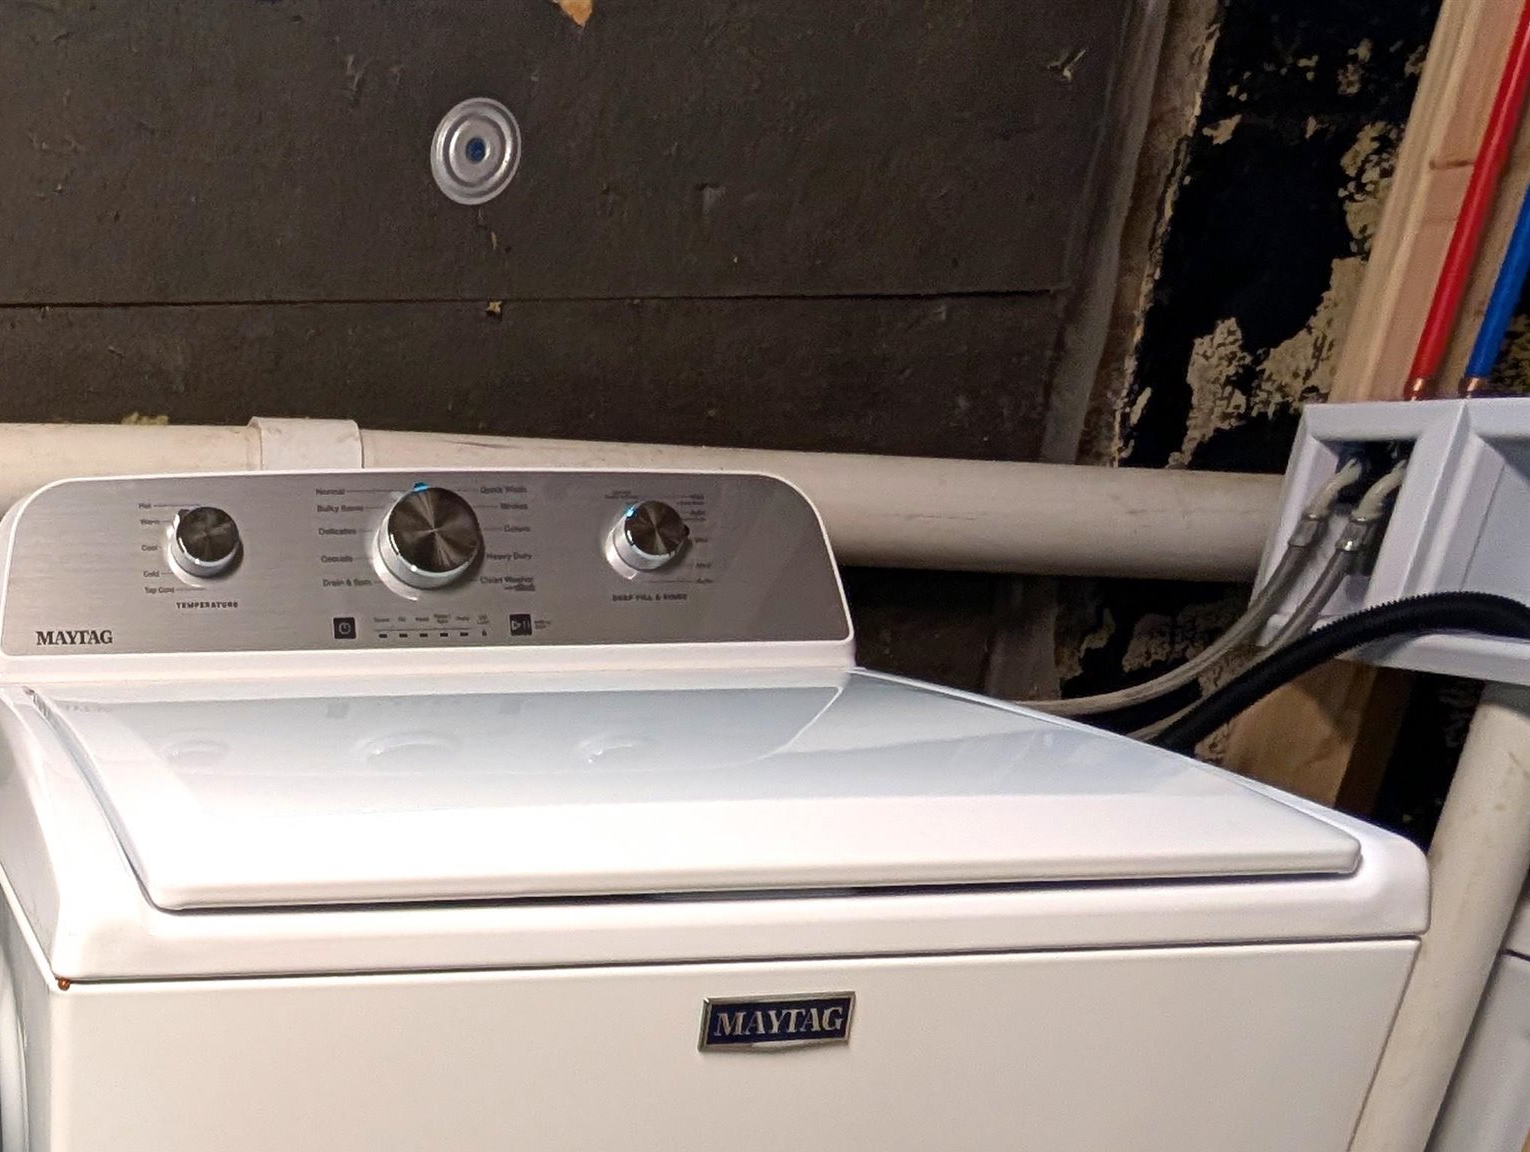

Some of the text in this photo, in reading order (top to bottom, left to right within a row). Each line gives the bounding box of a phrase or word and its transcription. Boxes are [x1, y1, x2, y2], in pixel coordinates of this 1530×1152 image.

[486, 552, 512, 561] Heavy
[36, 629, 113, 645] MAYTAG
[714, 1007, 843, 1036] MAYTAG
